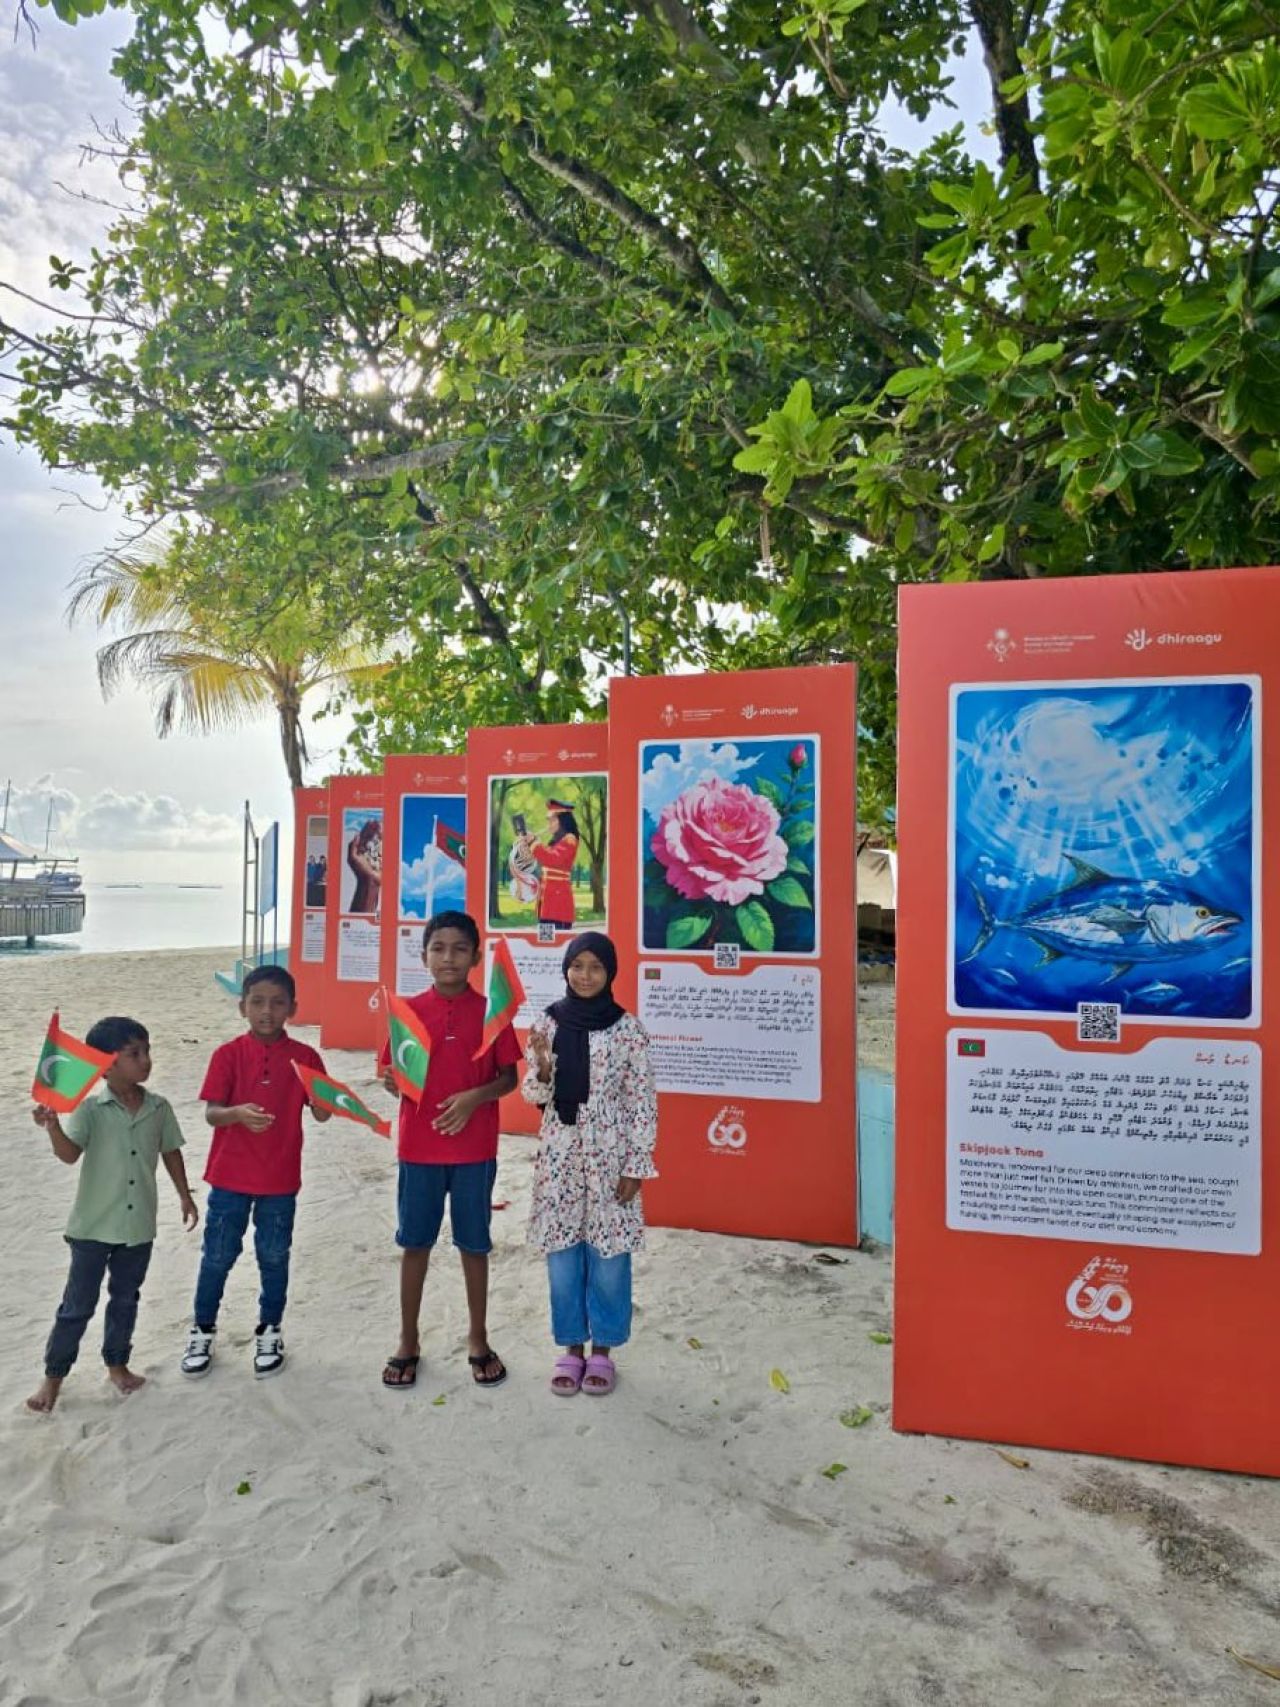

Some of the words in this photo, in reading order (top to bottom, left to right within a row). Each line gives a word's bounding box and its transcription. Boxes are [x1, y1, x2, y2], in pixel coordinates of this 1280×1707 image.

[1157, 632, 1222, 645] dhiraagu
[960, 1143, 1011, 1156] Skipjack
[1014, 1147, 1044, 1157] Tuna
[1066, 1256, 1132, 1322] 60
